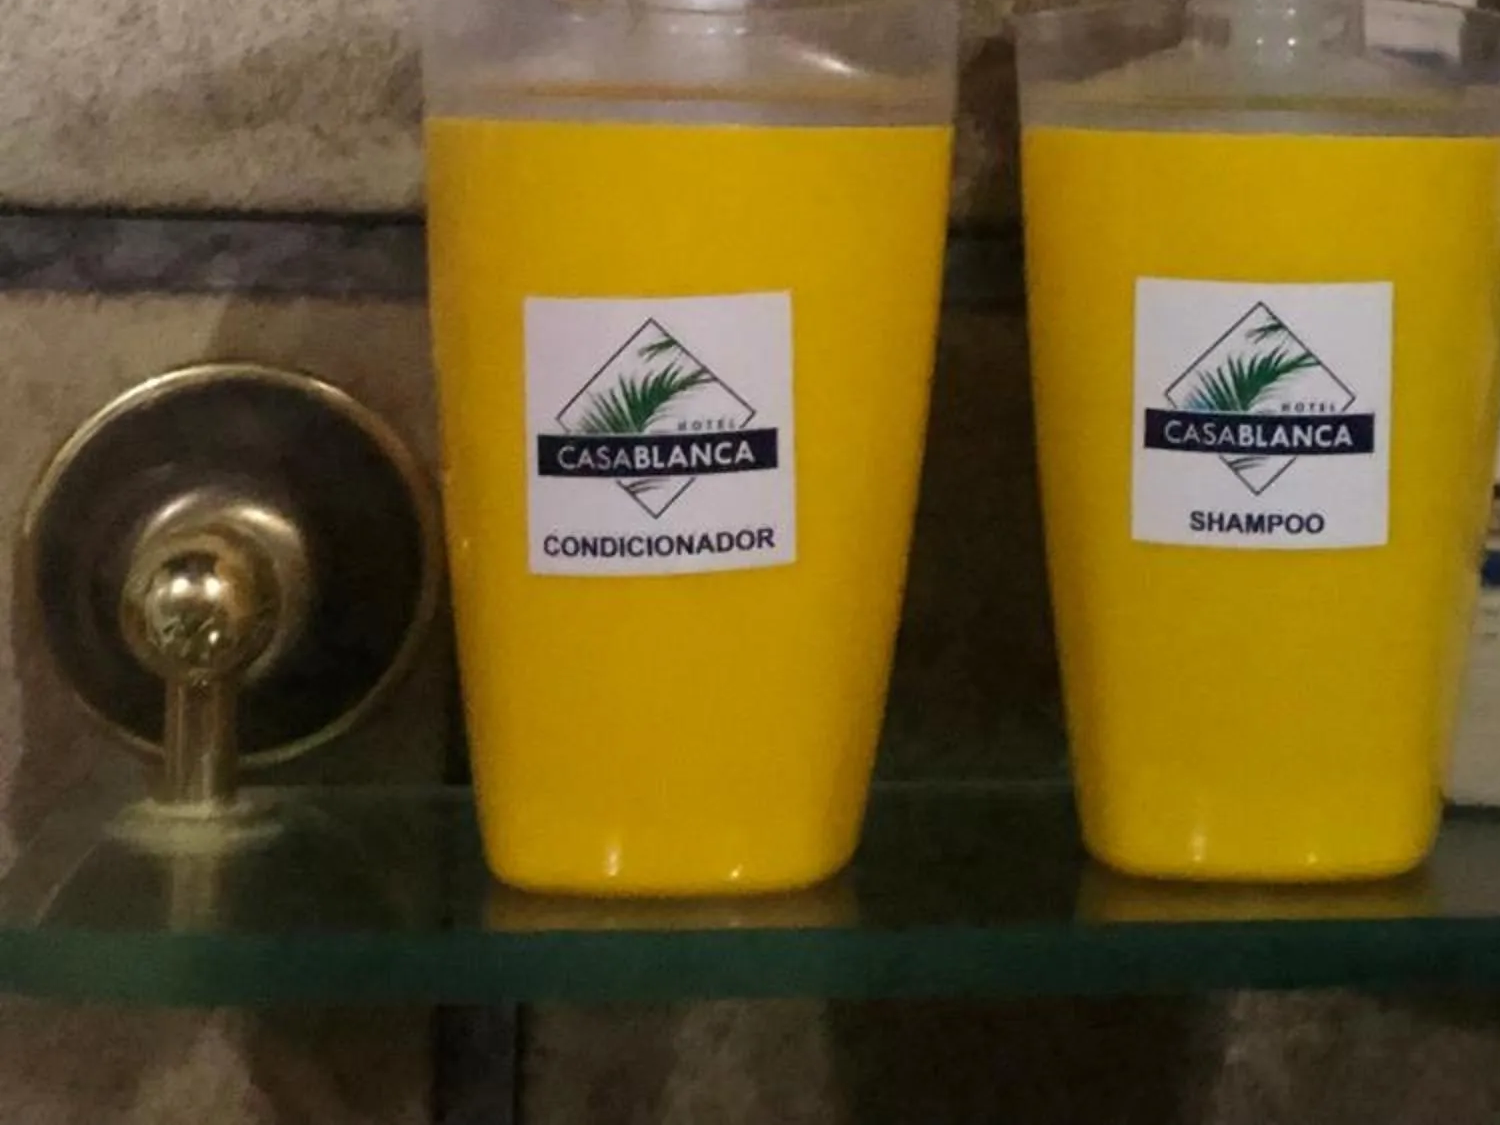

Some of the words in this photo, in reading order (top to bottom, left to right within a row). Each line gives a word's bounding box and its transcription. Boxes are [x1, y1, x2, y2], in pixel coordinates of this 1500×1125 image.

[1281, 402, 1336, 413] HOTEL
[677, 419, 736, 432] HOTEL
[1164, 420, 1353, 449] CASABLANCA
[556, 440, 756, 470] CASABLANCA
[1189, 510, 1325, 535] SHAMPOO
[543, 527, 776, 559] CONDICIONADOR
